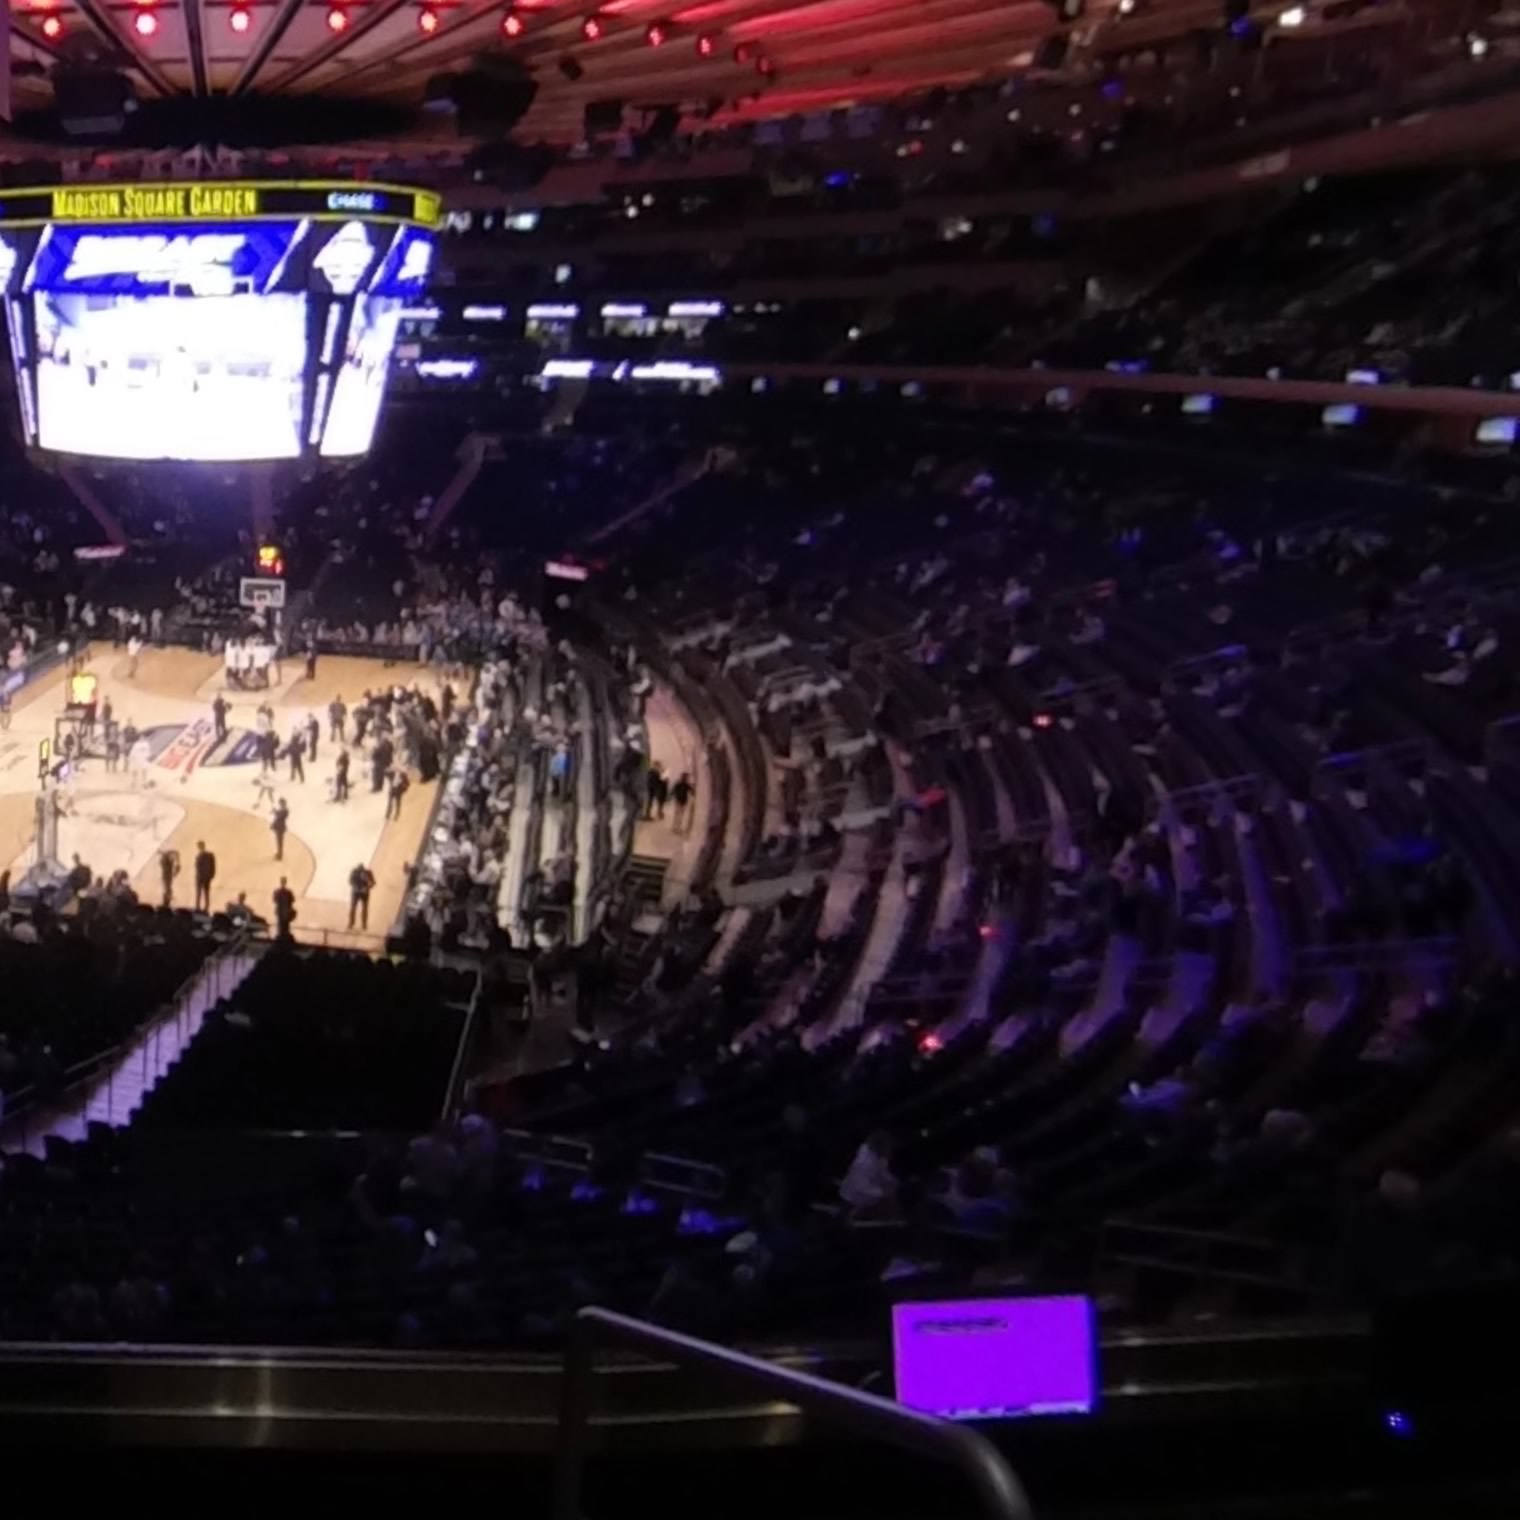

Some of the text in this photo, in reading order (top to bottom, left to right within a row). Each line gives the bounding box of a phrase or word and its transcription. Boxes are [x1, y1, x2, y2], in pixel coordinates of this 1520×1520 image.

[53, 185, 256, 217] MADISON SQUARE GARDEN
